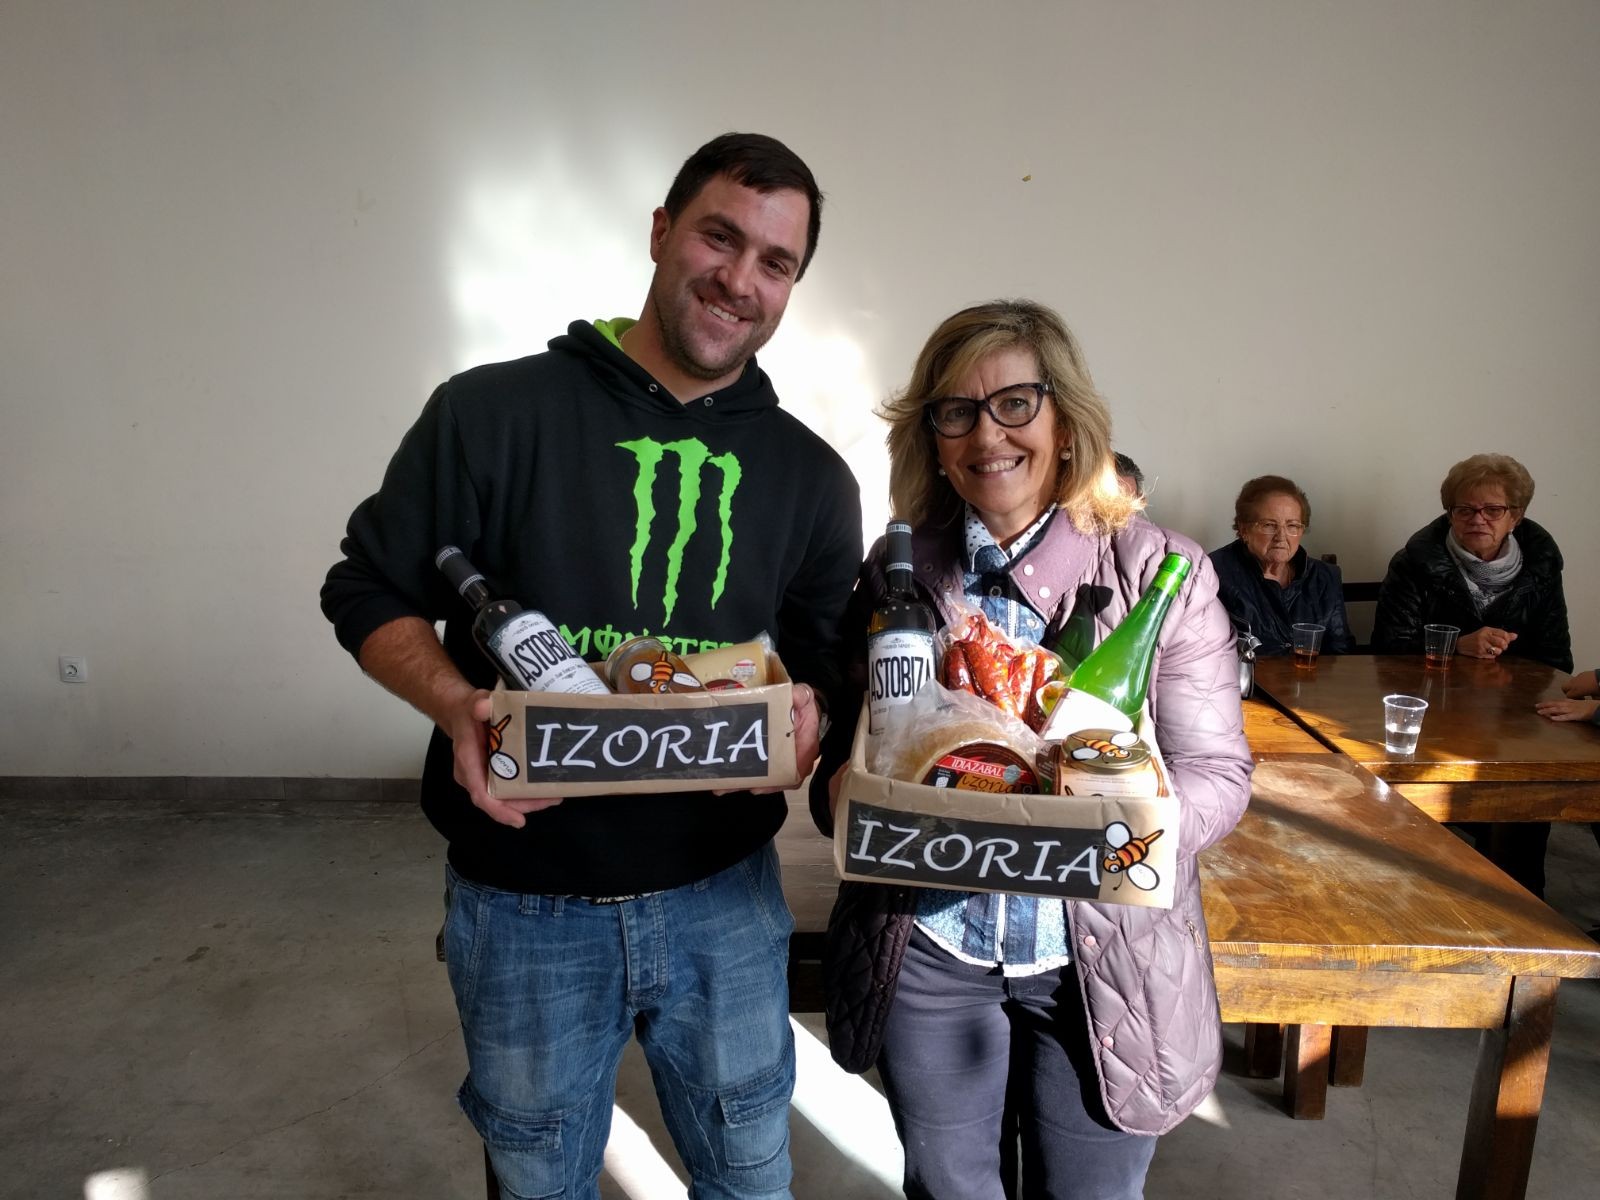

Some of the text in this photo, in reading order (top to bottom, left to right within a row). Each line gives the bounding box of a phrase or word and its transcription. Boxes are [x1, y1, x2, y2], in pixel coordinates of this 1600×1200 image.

[509, 629, 579, 687] ASTOBIZ
[871, 656, 931, 702] ASTOBIZA
[531, 719, 768, 769] IZORIA
[951, 758, 1002, 777] IDIAZABAL
[850, 816, 1101, 886] IZORIA
